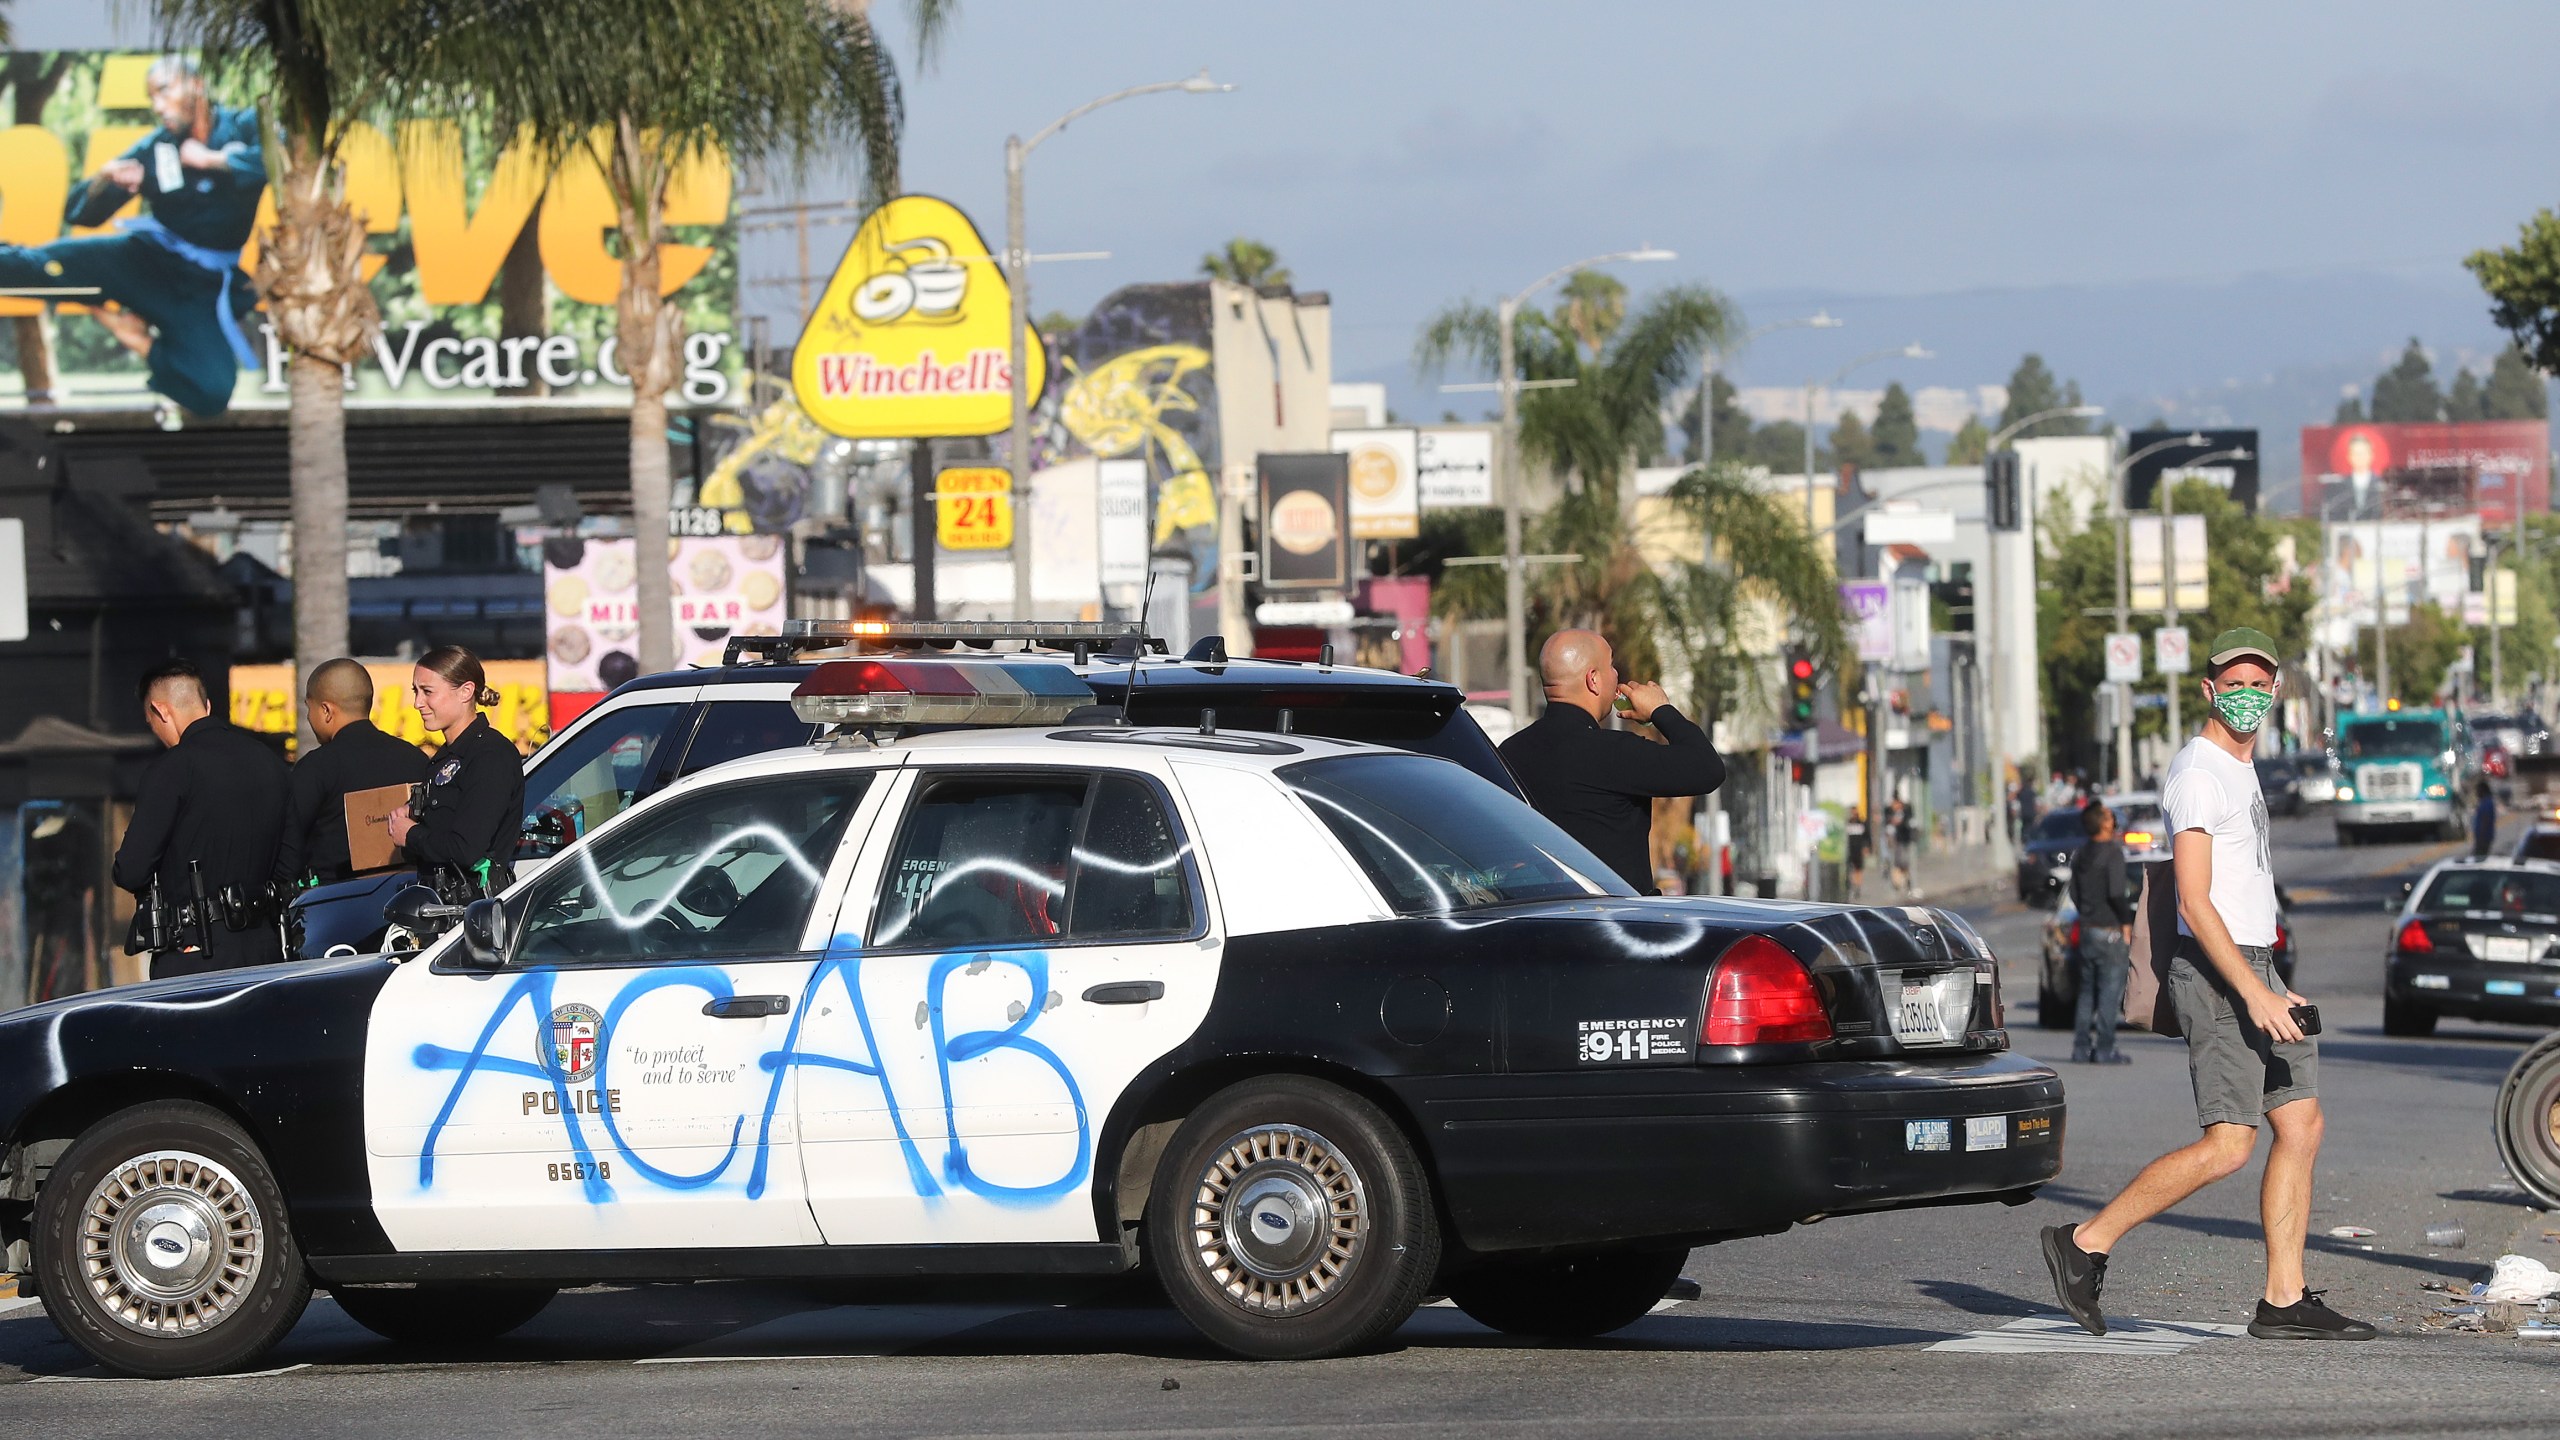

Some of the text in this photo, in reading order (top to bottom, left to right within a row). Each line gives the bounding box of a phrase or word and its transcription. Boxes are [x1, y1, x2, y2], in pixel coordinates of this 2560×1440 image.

[821, 353, 1012, 395] Winchell's
[954, 497, 997, 527] 24
[681, 602, 741, 620] BAR
[1578, 1018, 1687, 1031] EMERGENCY
[652, 1045, 704, 1069] protect
[1580, 1033, 1589, 1061] CALL
[1588, 1030, 1649, 1061] 9-1-1
[412, 932, 1092, 1204] ACAB
[642, 1067, 673, 1085] and
[678, 1067, 693, 1084] to
[522, 1089, 621, 1116] POLICE
[1976, 1120, 2001, 1136] LAPD
[547, 1161, 611, 1181] 85678
